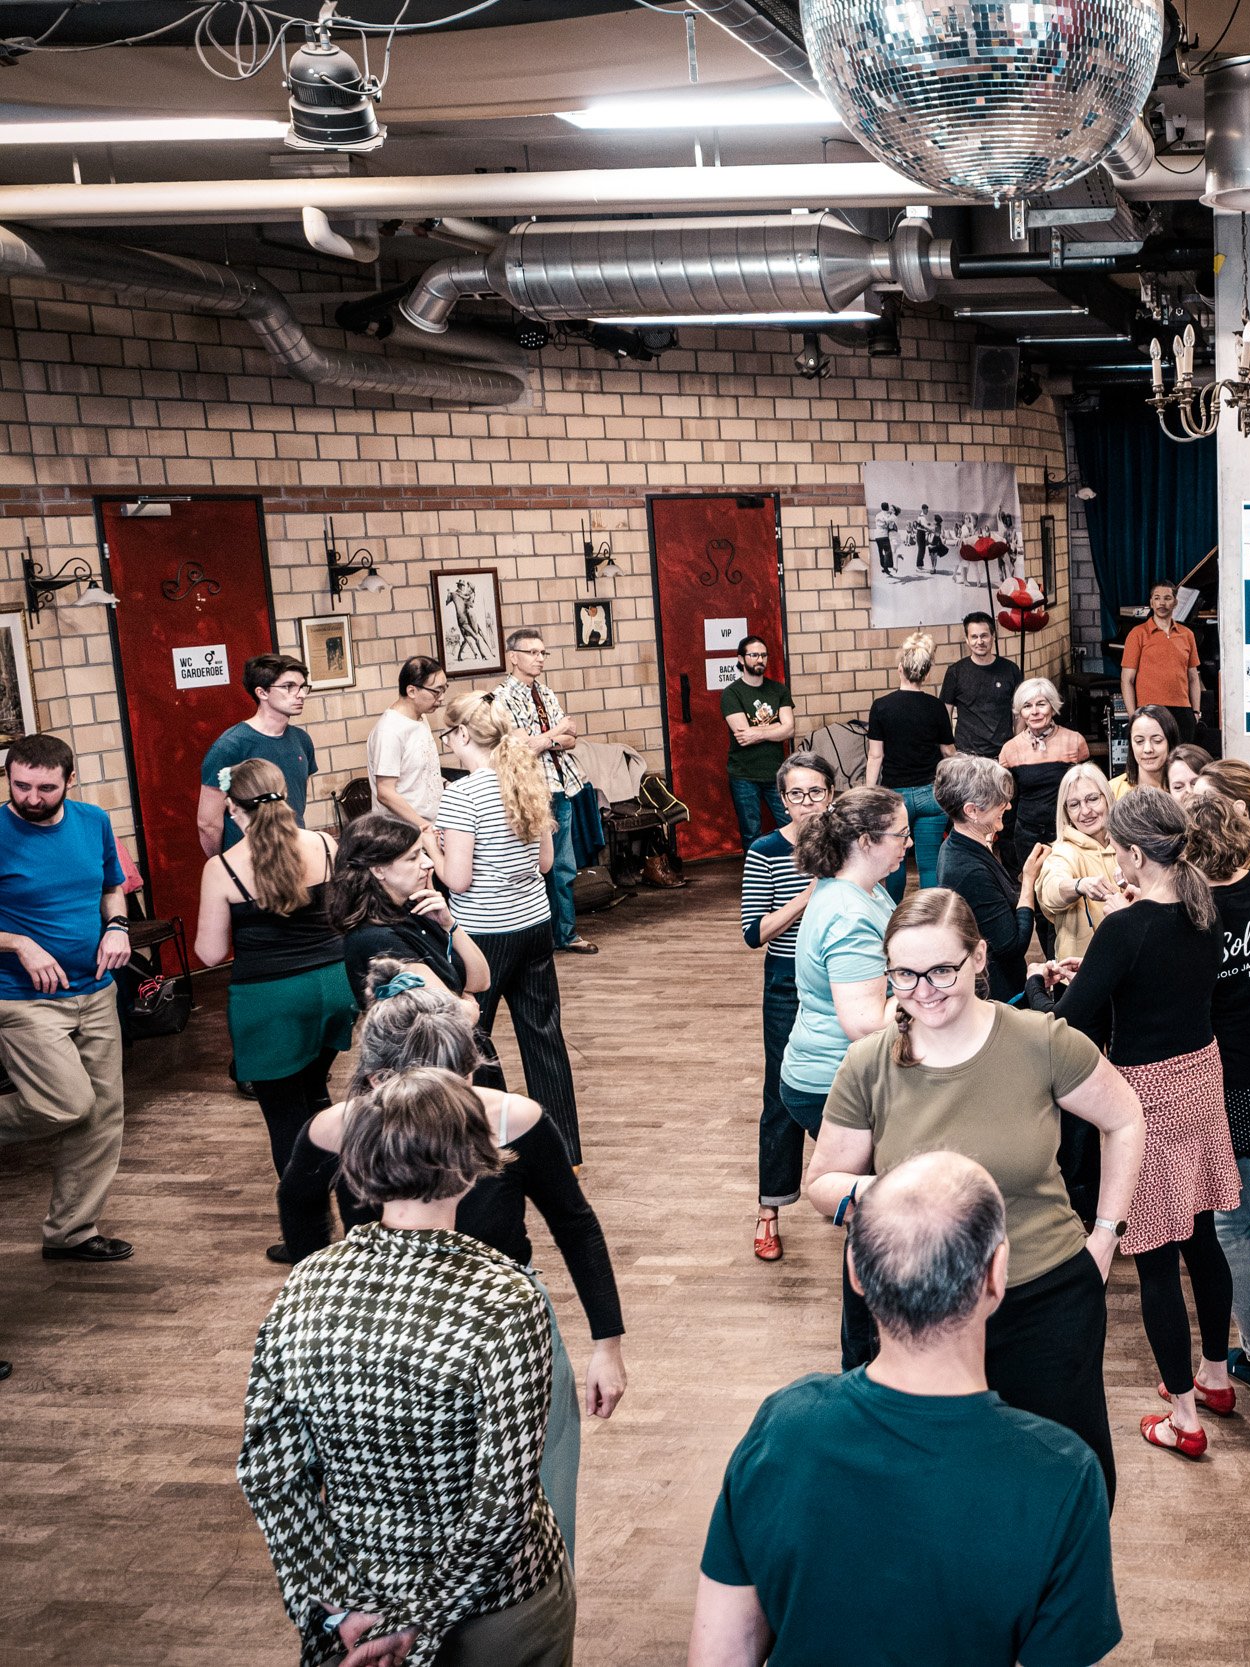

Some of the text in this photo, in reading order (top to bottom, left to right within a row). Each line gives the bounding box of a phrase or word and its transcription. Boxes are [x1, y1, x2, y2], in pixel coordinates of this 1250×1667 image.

[721, 628, 732, 637] VIP
[180, 657, 193, 667] WC
[181, 666, 223, 679] GARDEROBE
[719, 665, 735, 674] BACK
[718, 674, 736, 683] STAGE
